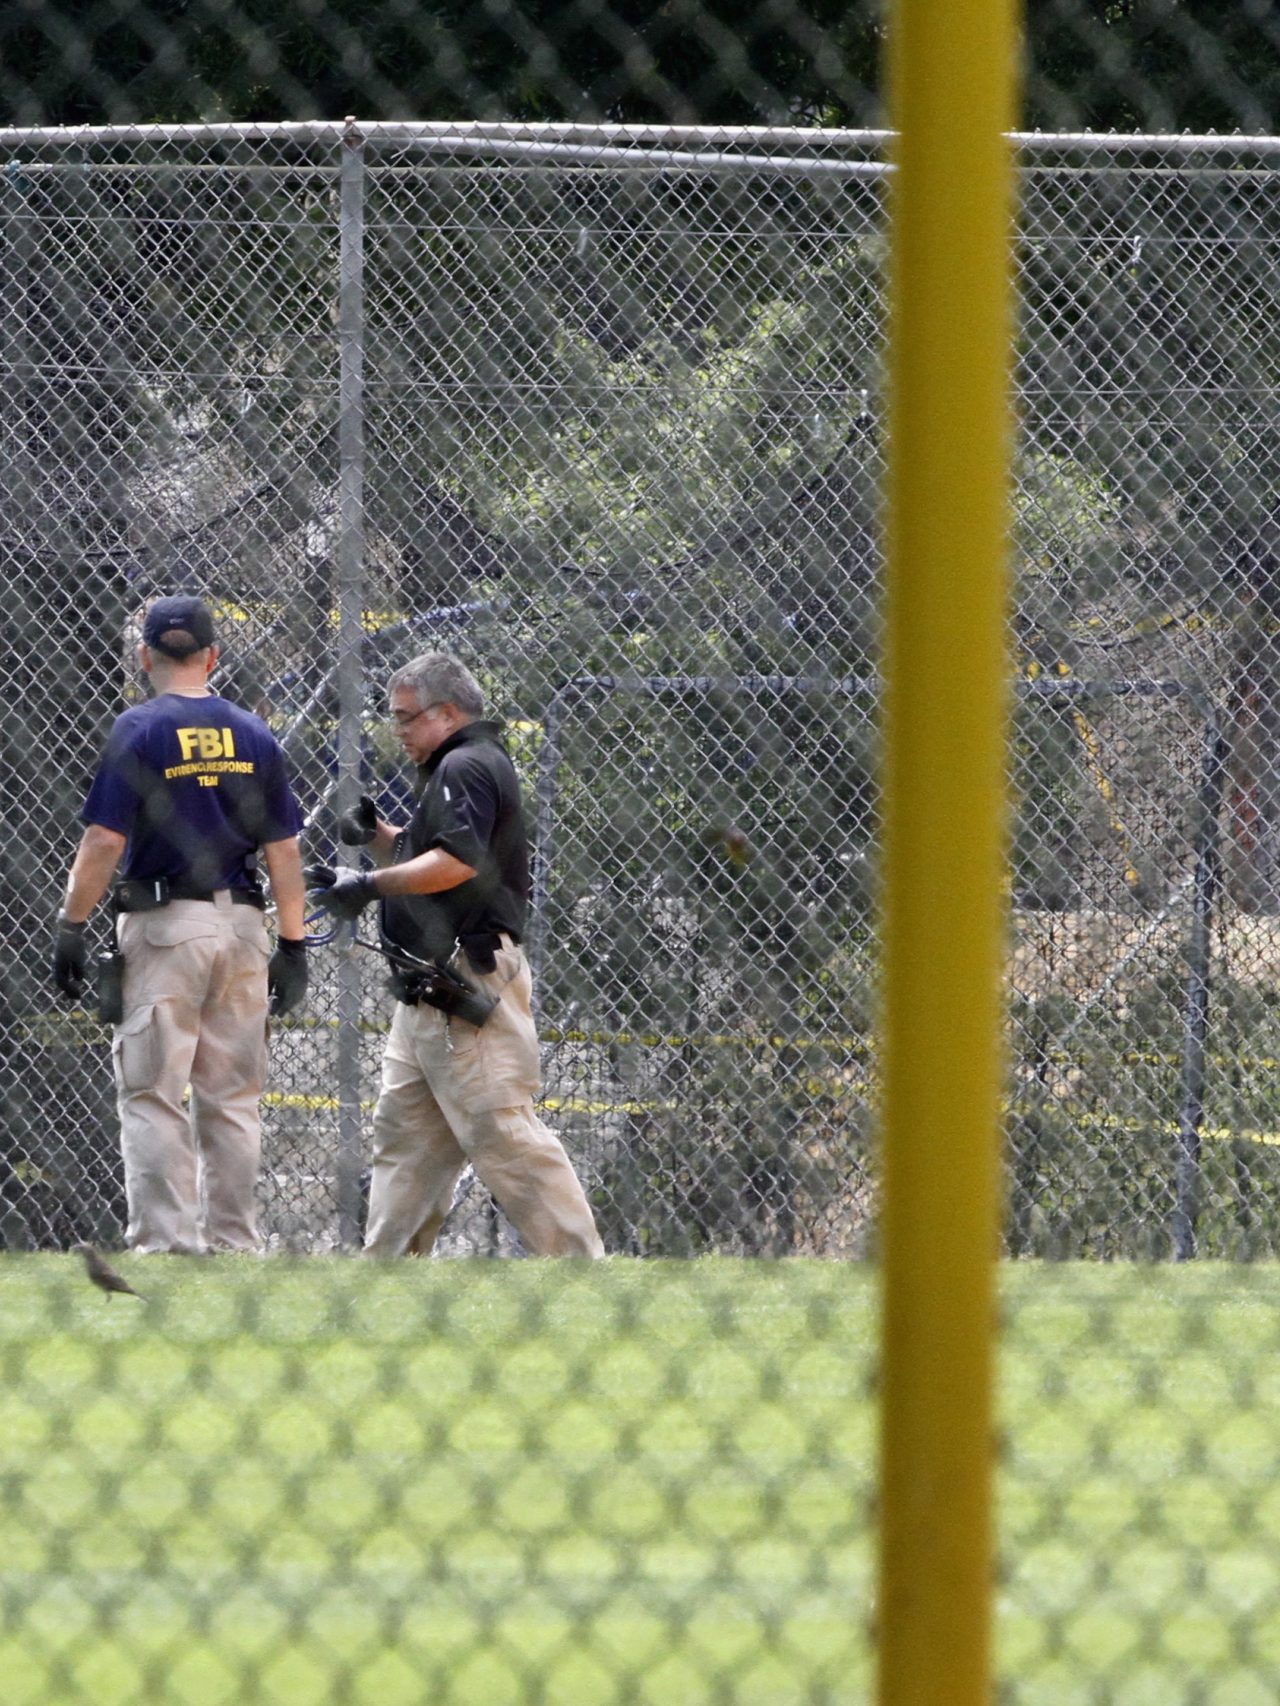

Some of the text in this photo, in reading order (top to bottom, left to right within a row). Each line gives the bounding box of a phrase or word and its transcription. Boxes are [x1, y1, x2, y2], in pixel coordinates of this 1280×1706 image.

[176, 727, 235, 760] FBI
[165, 761, 254, 779] EVIDENC RESPONSE
